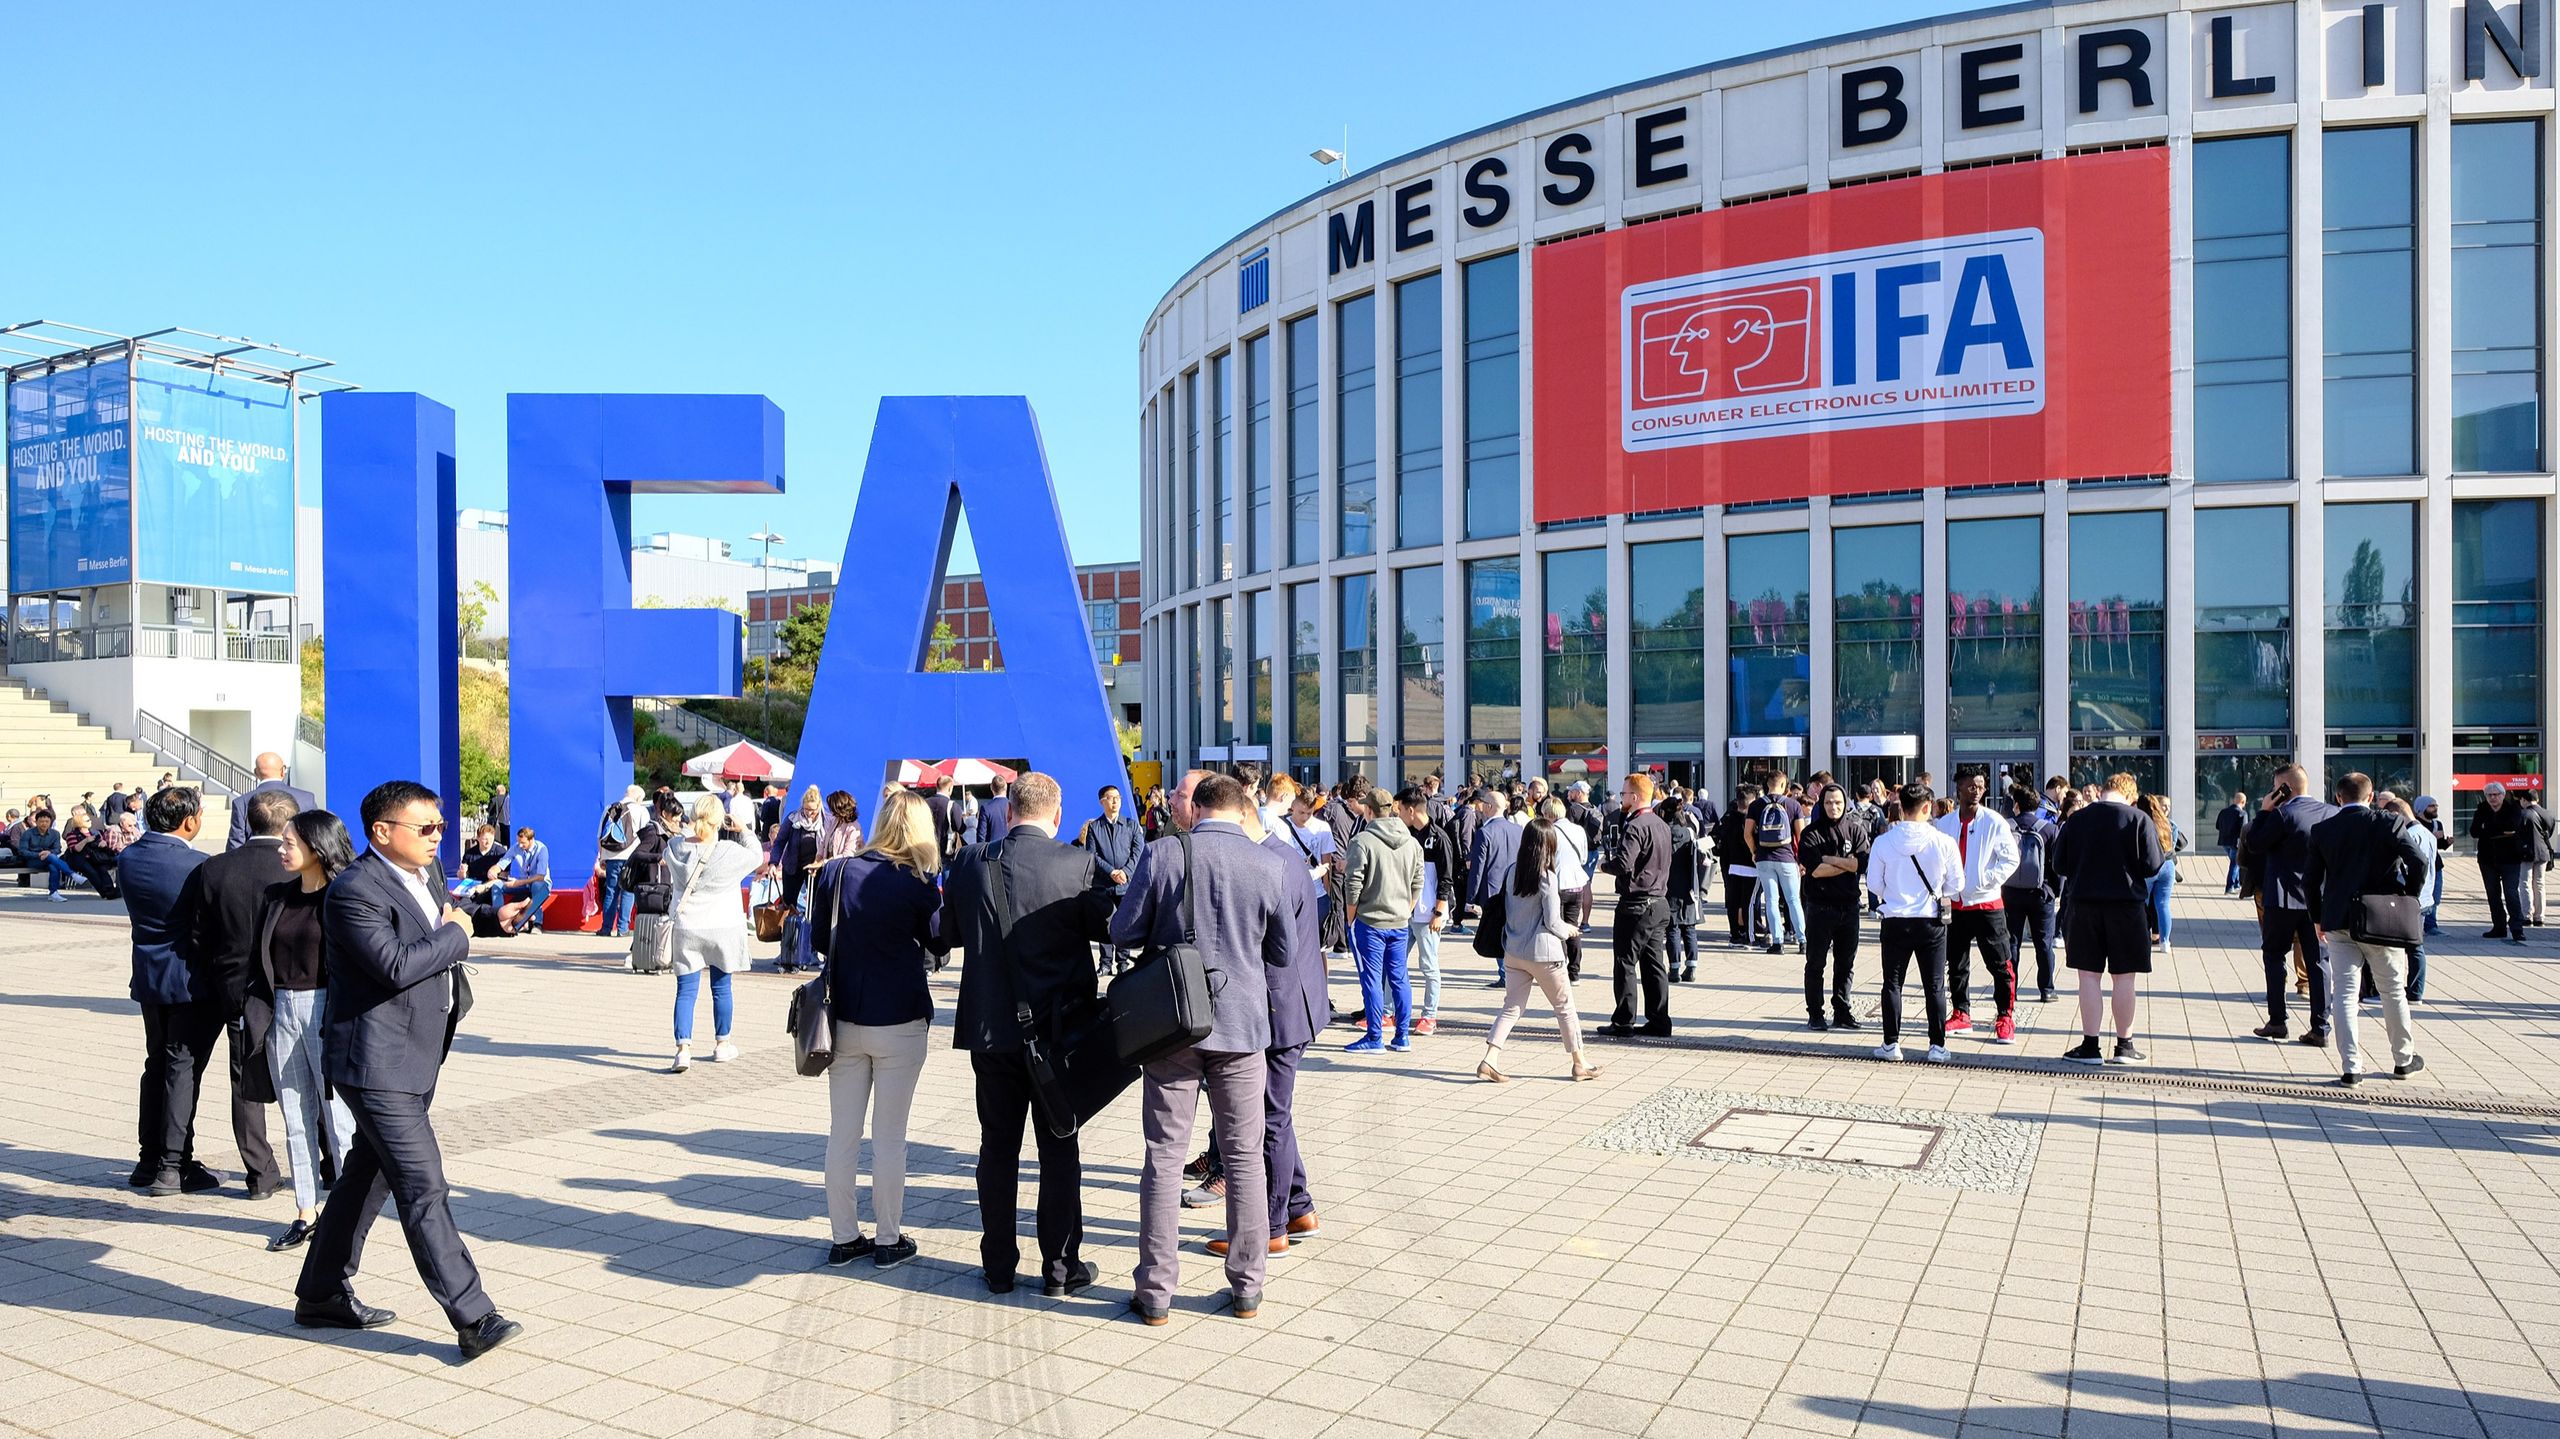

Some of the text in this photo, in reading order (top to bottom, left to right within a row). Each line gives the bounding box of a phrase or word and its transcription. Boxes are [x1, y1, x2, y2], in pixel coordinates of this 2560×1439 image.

[1329, 0, 2541, 276] MESSE BERLIN
[1831, 253, 2034, 387] IFA
[1631, 378, 2036, 432] CONSUMER ELECTRONICS UNLIMITED
[13, 428, 126, 468] HOSTING THE WORLD.
[144, 426, 289, 462] HOSTING THE WORLD.
[177, 446, 260, 474] AND YOU.
[36, 455, 101, 490] AND YOU.
[89, 556, 128, 570] Messe Berlin
[244, 564, 289, 576] Messe Berlin
[321, 393, 1133, 888] IFA
